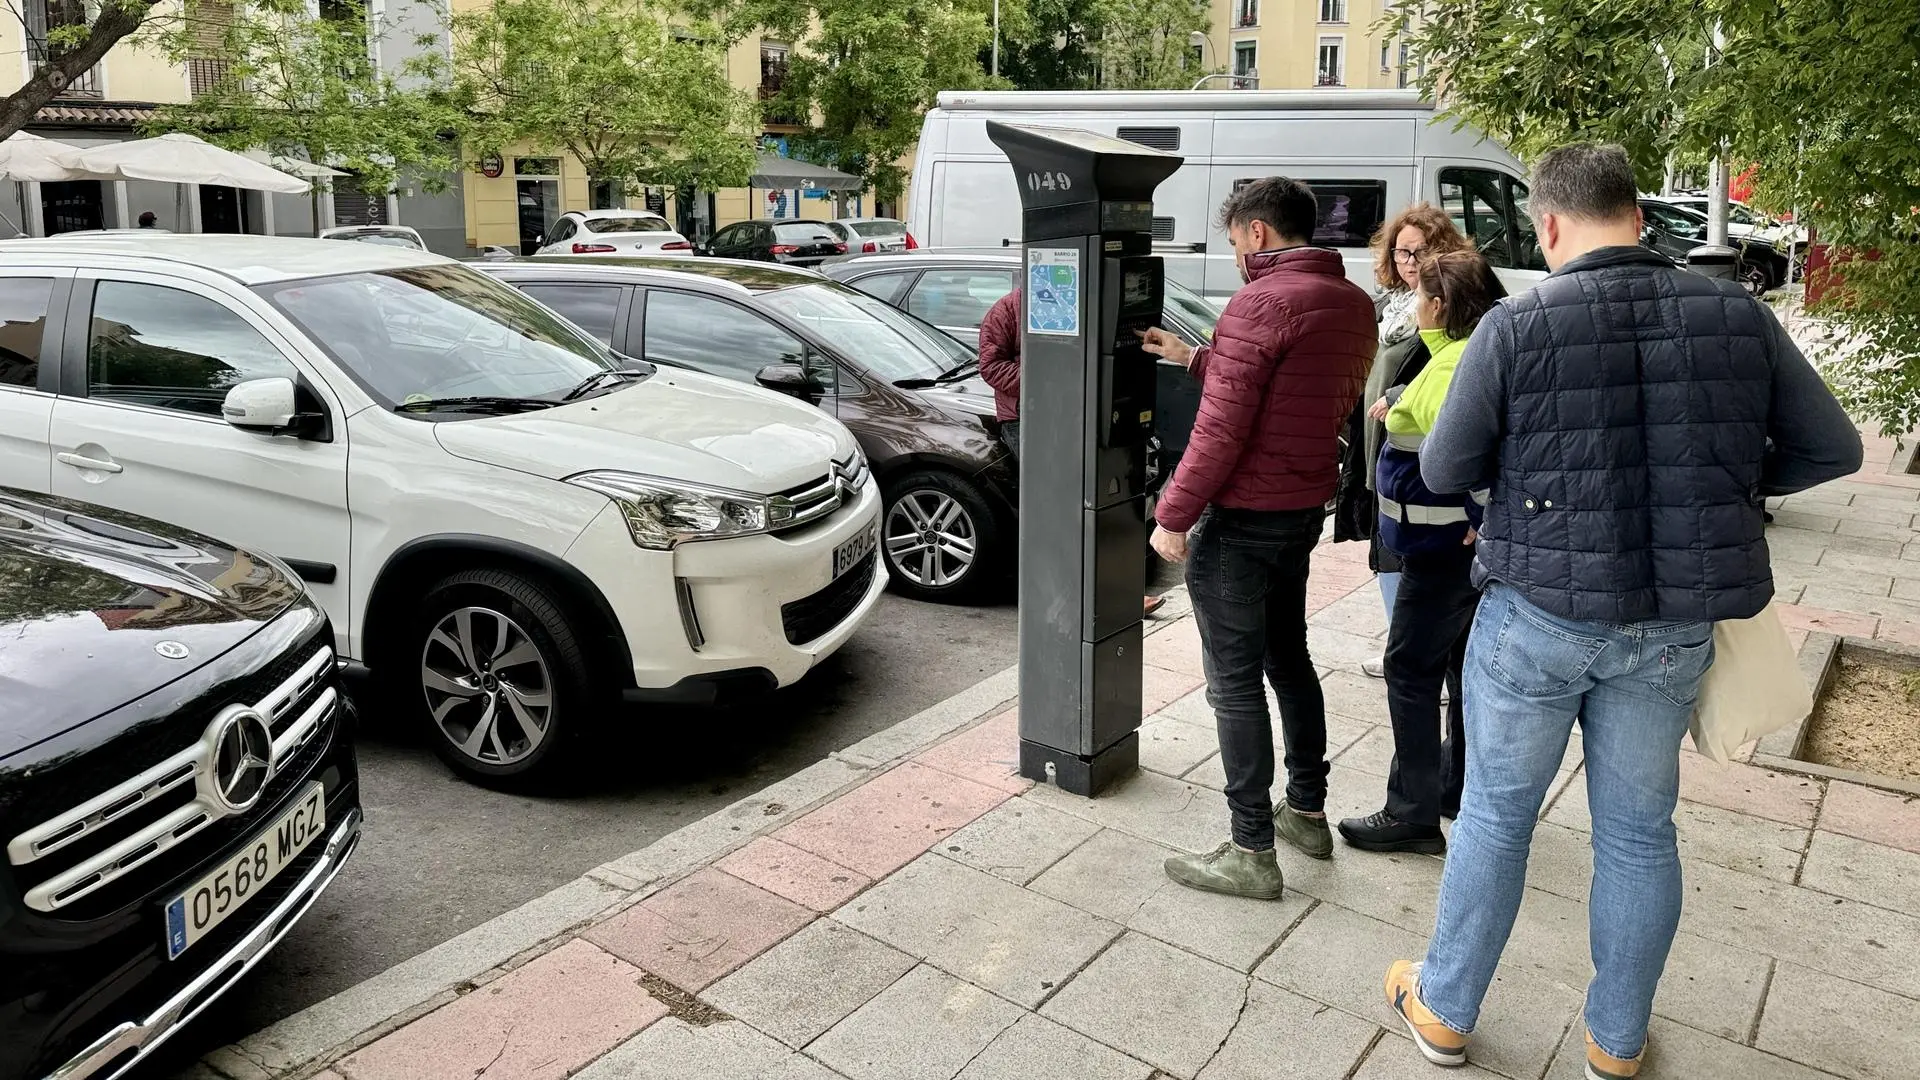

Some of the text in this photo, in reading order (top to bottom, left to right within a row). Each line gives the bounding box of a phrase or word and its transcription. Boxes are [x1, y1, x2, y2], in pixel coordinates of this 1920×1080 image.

[1028, 171, 1072, 191] 049
[840, 535, 864, 570] 6979
[192, 794, 319, 930] 0568 MGZ
[174, 931, 182, 946] E
